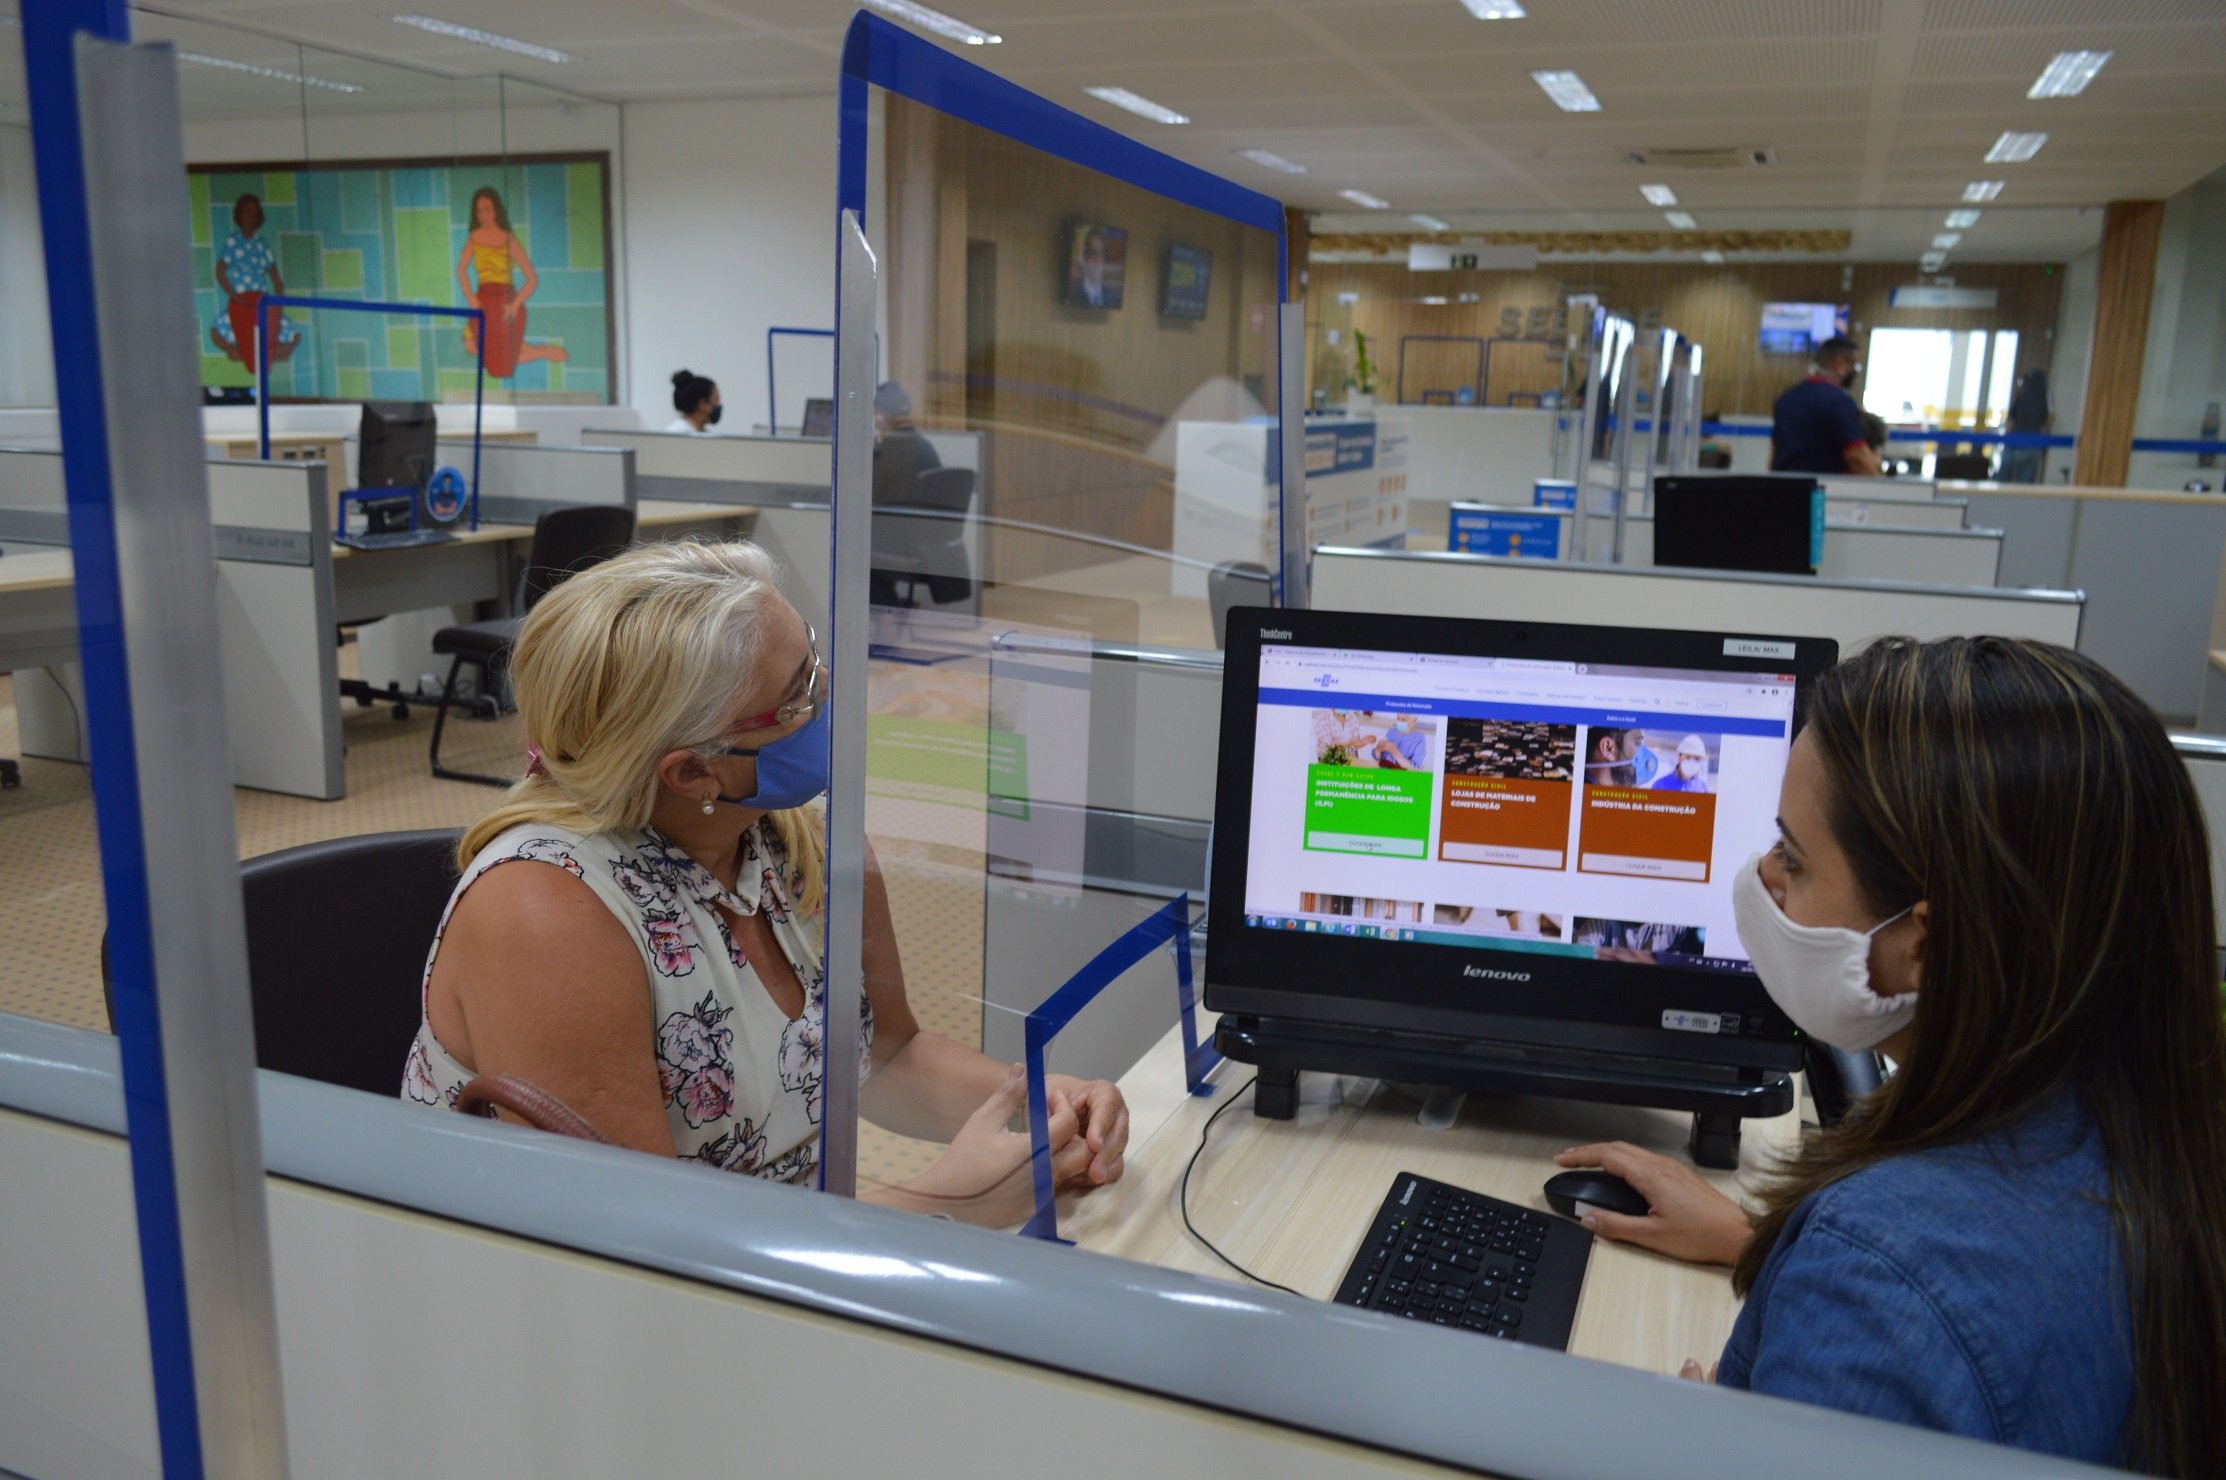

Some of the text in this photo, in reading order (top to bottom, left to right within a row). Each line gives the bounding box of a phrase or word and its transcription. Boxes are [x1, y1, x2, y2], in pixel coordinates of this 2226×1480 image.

[1763, 646, 1779, 654] MAX
[1315, 780, 1402, 792] INSTITUIÇÕES DE LONGA
[1315, 789, 1414, 804] PERMANÊNCIA PARA IDOSOS
[1451, 789, 1474, 798] LOJAS
[1486, 791, 1525, 802] MATERIAIS
[1526, 795, 1536, 803] DE
[1450, 800, 1501, 811] CONSTRUÇÃO
[1591, 799, 1697, 815] INDÚSTRIA DA CONSTRUÇÃO
[1463, 964, 1531, 982] lenovo
